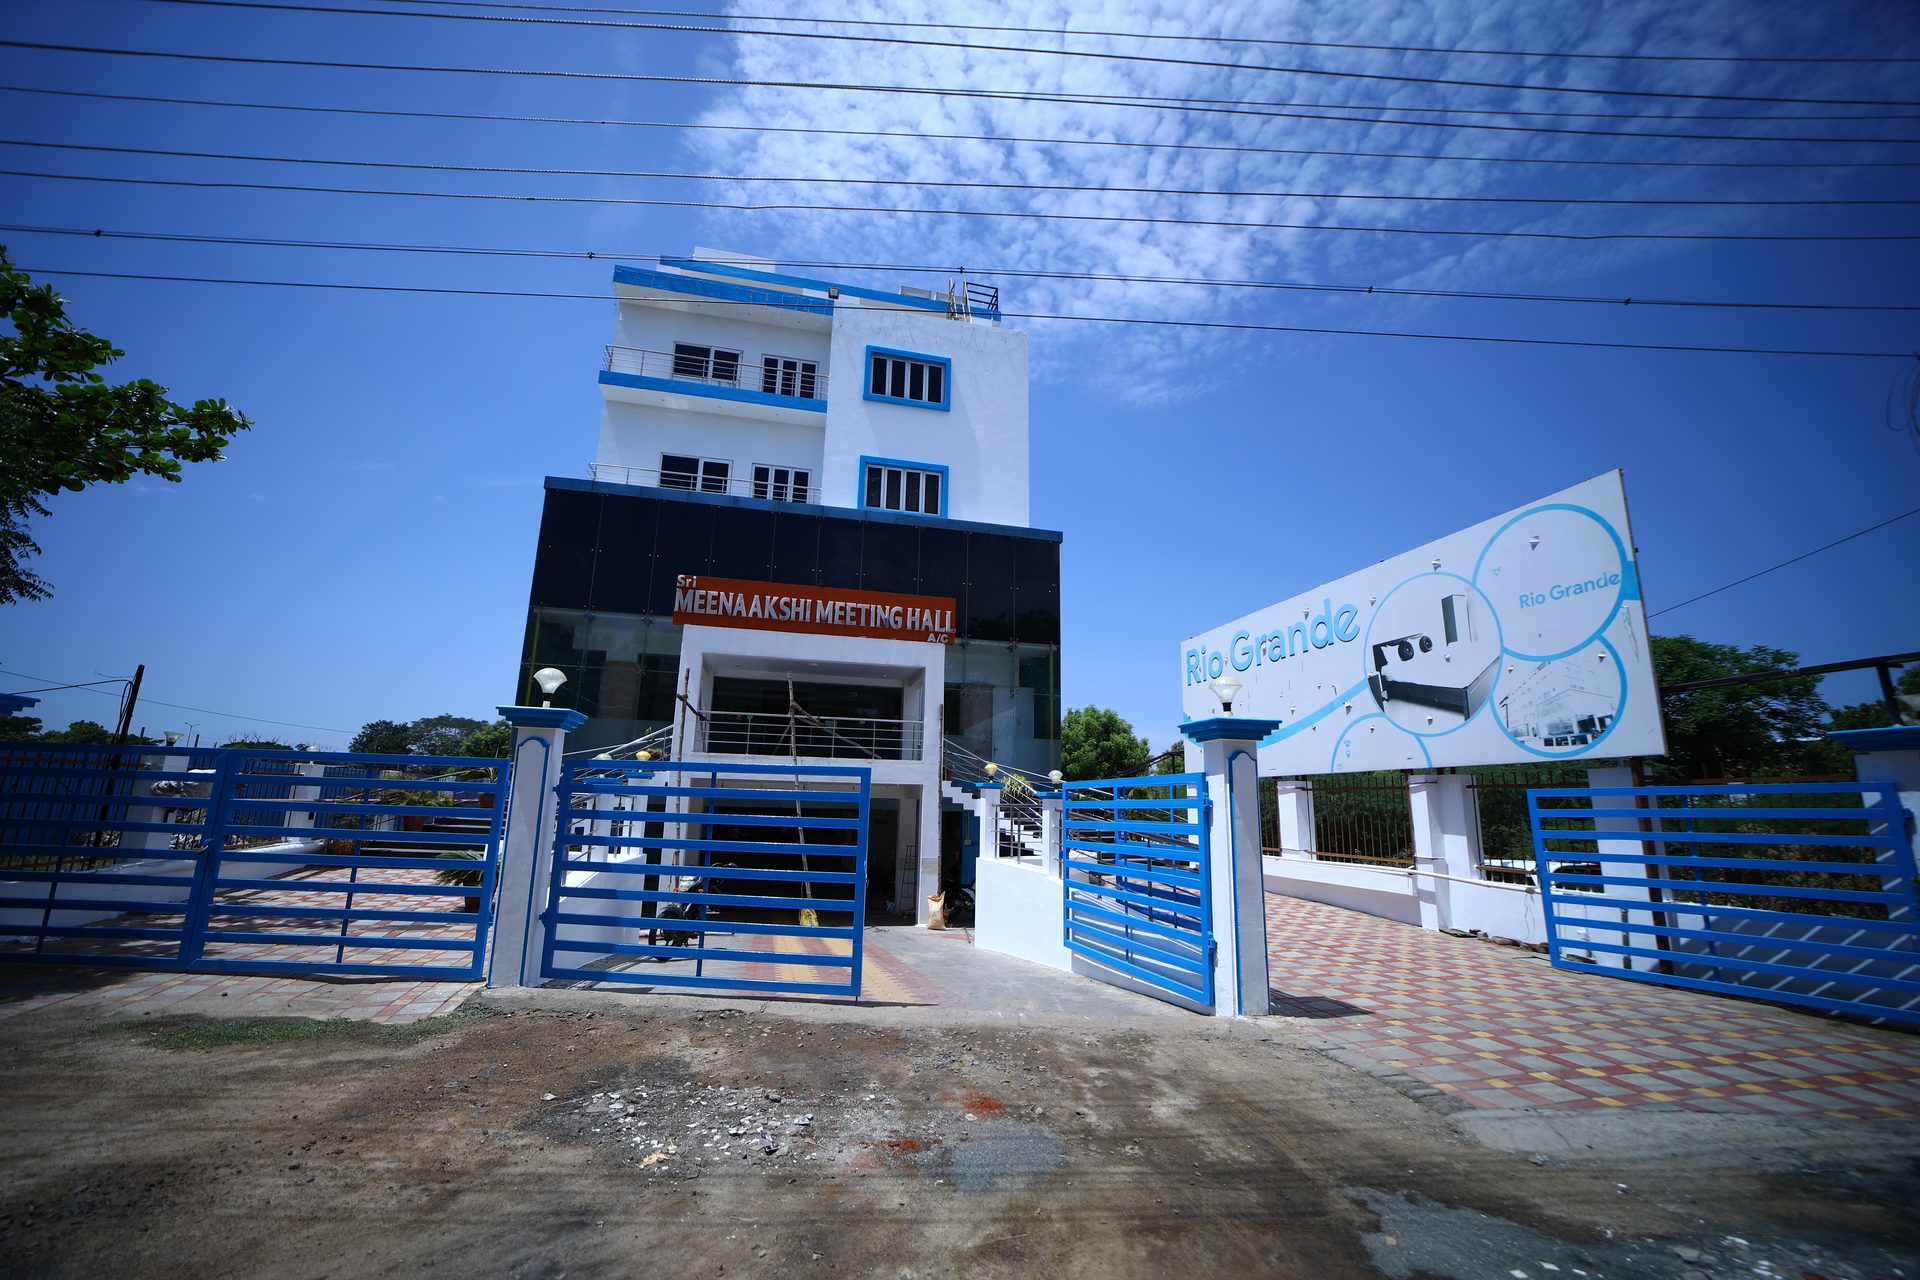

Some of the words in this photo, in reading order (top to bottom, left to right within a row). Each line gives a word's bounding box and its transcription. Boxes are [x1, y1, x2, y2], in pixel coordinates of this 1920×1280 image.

[676, 574, 697, 588] Sri
[1519, 592, 1546, 609] Rio
[1549, 572, 1621, 601] Grande
[674, 587, 812, 622] MEENAAKSHI
[815, 599, 903, 629] MEETING
[906, 607, 956, 633] HALL
[927, 633, 949, 643] A/C
[1186, 645, 1224, 686] Rio
[1230, 598, 1361, 671] Grande
